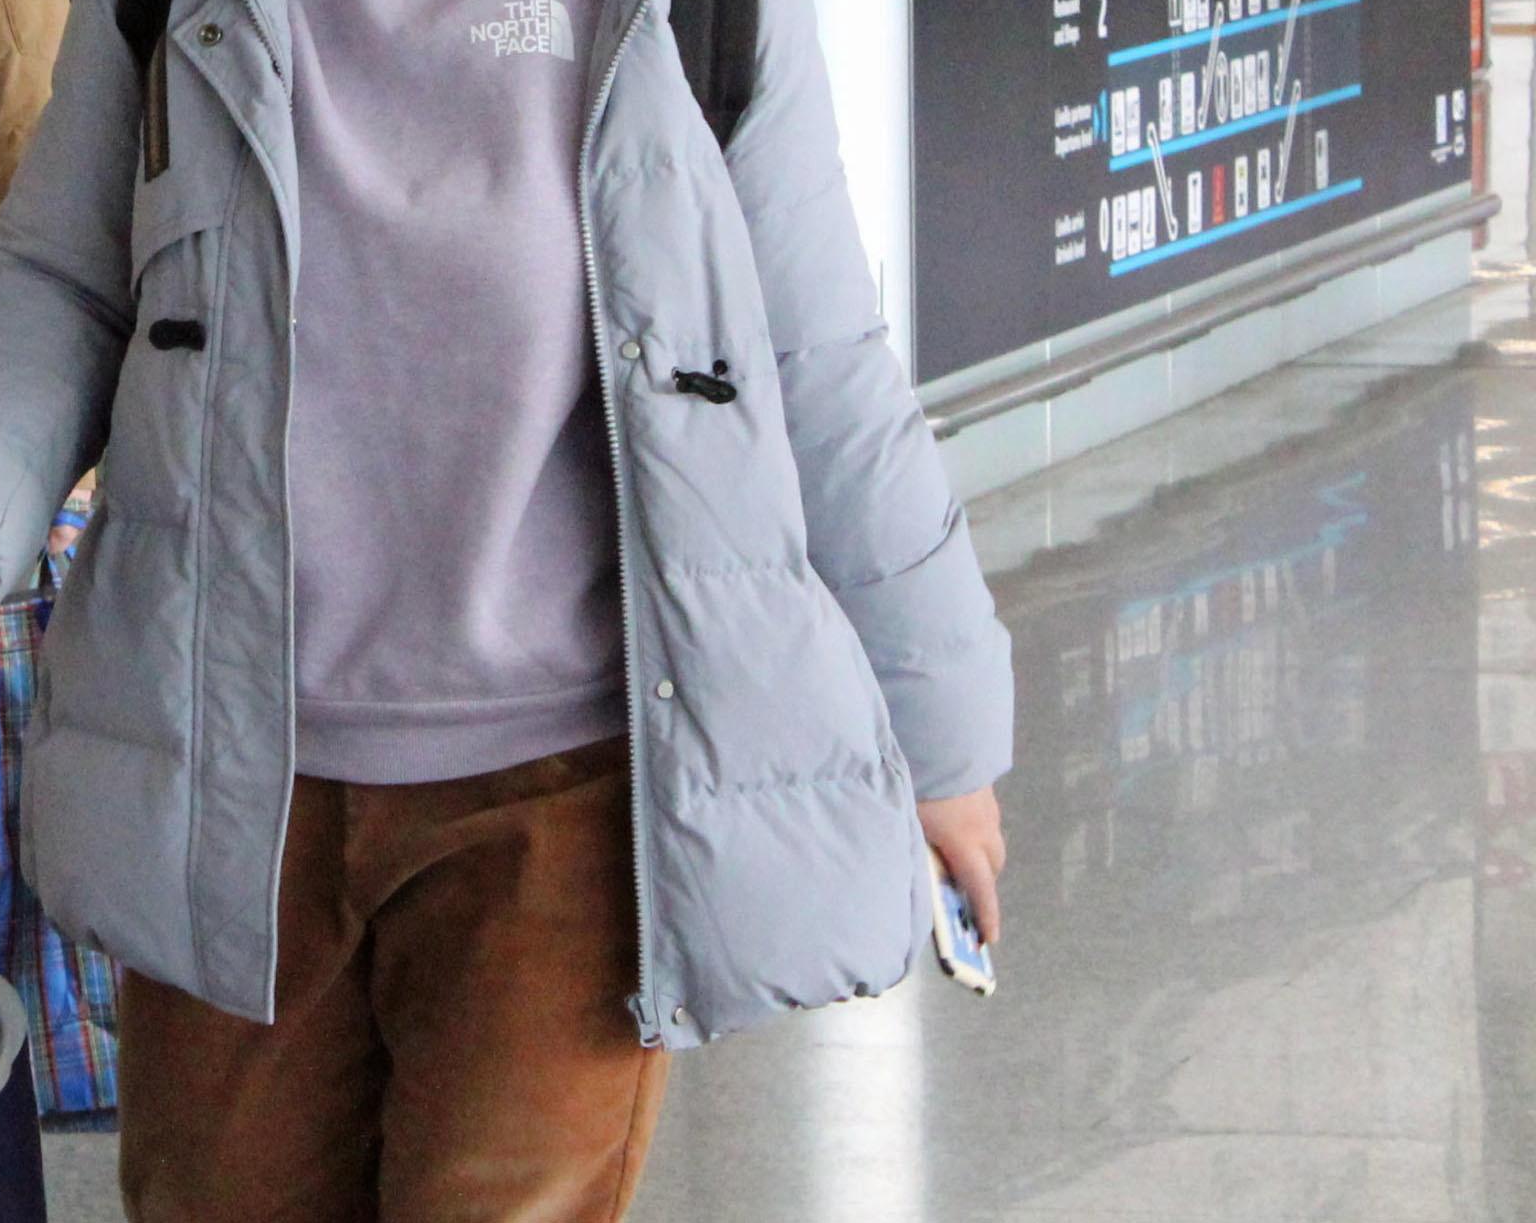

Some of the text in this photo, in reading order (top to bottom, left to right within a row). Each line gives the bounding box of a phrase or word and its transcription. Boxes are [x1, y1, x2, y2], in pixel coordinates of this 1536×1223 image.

[504, 0, 550, 19] THE
[470, 17, 550, 44] NORTH
[495, 35, 550, 57] FACE
